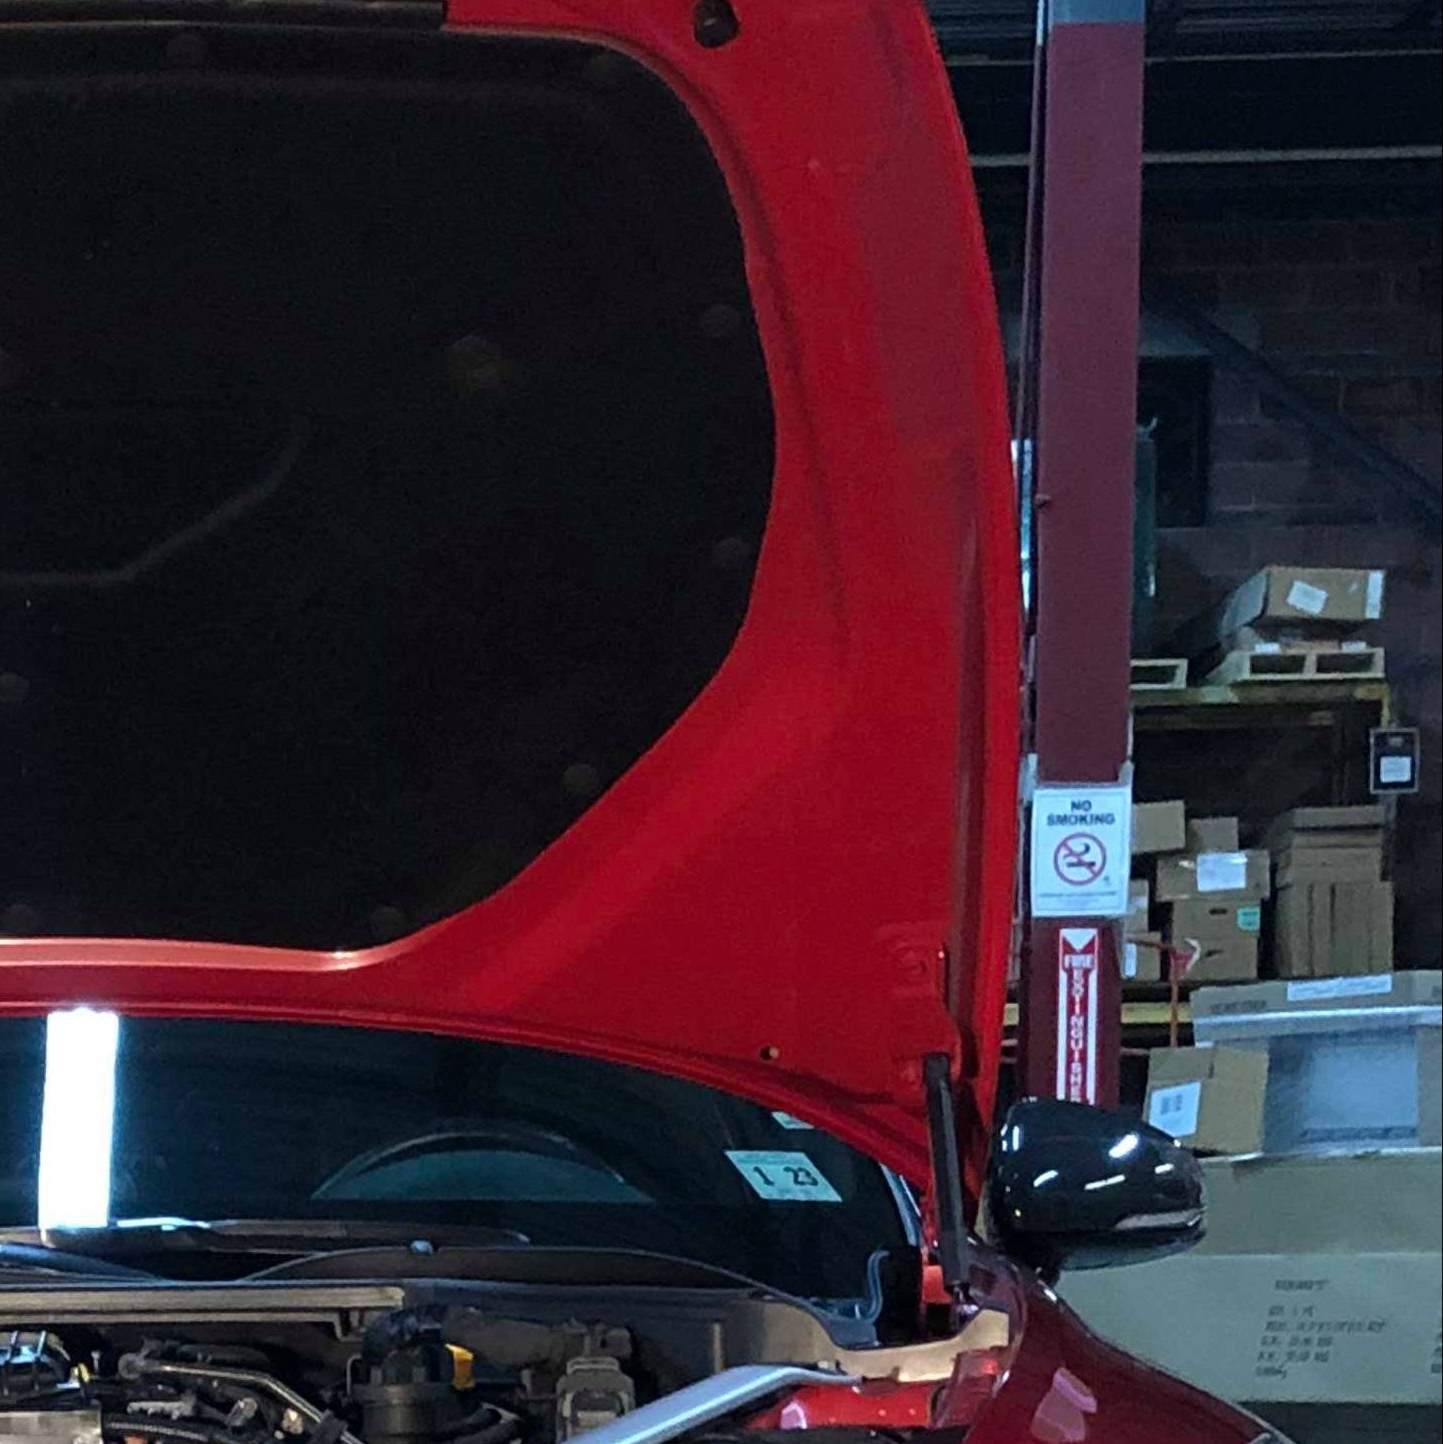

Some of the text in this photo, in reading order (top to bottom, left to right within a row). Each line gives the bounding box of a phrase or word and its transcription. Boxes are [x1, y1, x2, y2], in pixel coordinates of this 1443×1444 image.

[1070, 800, 1092, 812] NO
[1046, 813, 1116, 827] SMOKING
[753, 1166, 775, 1187] 1
